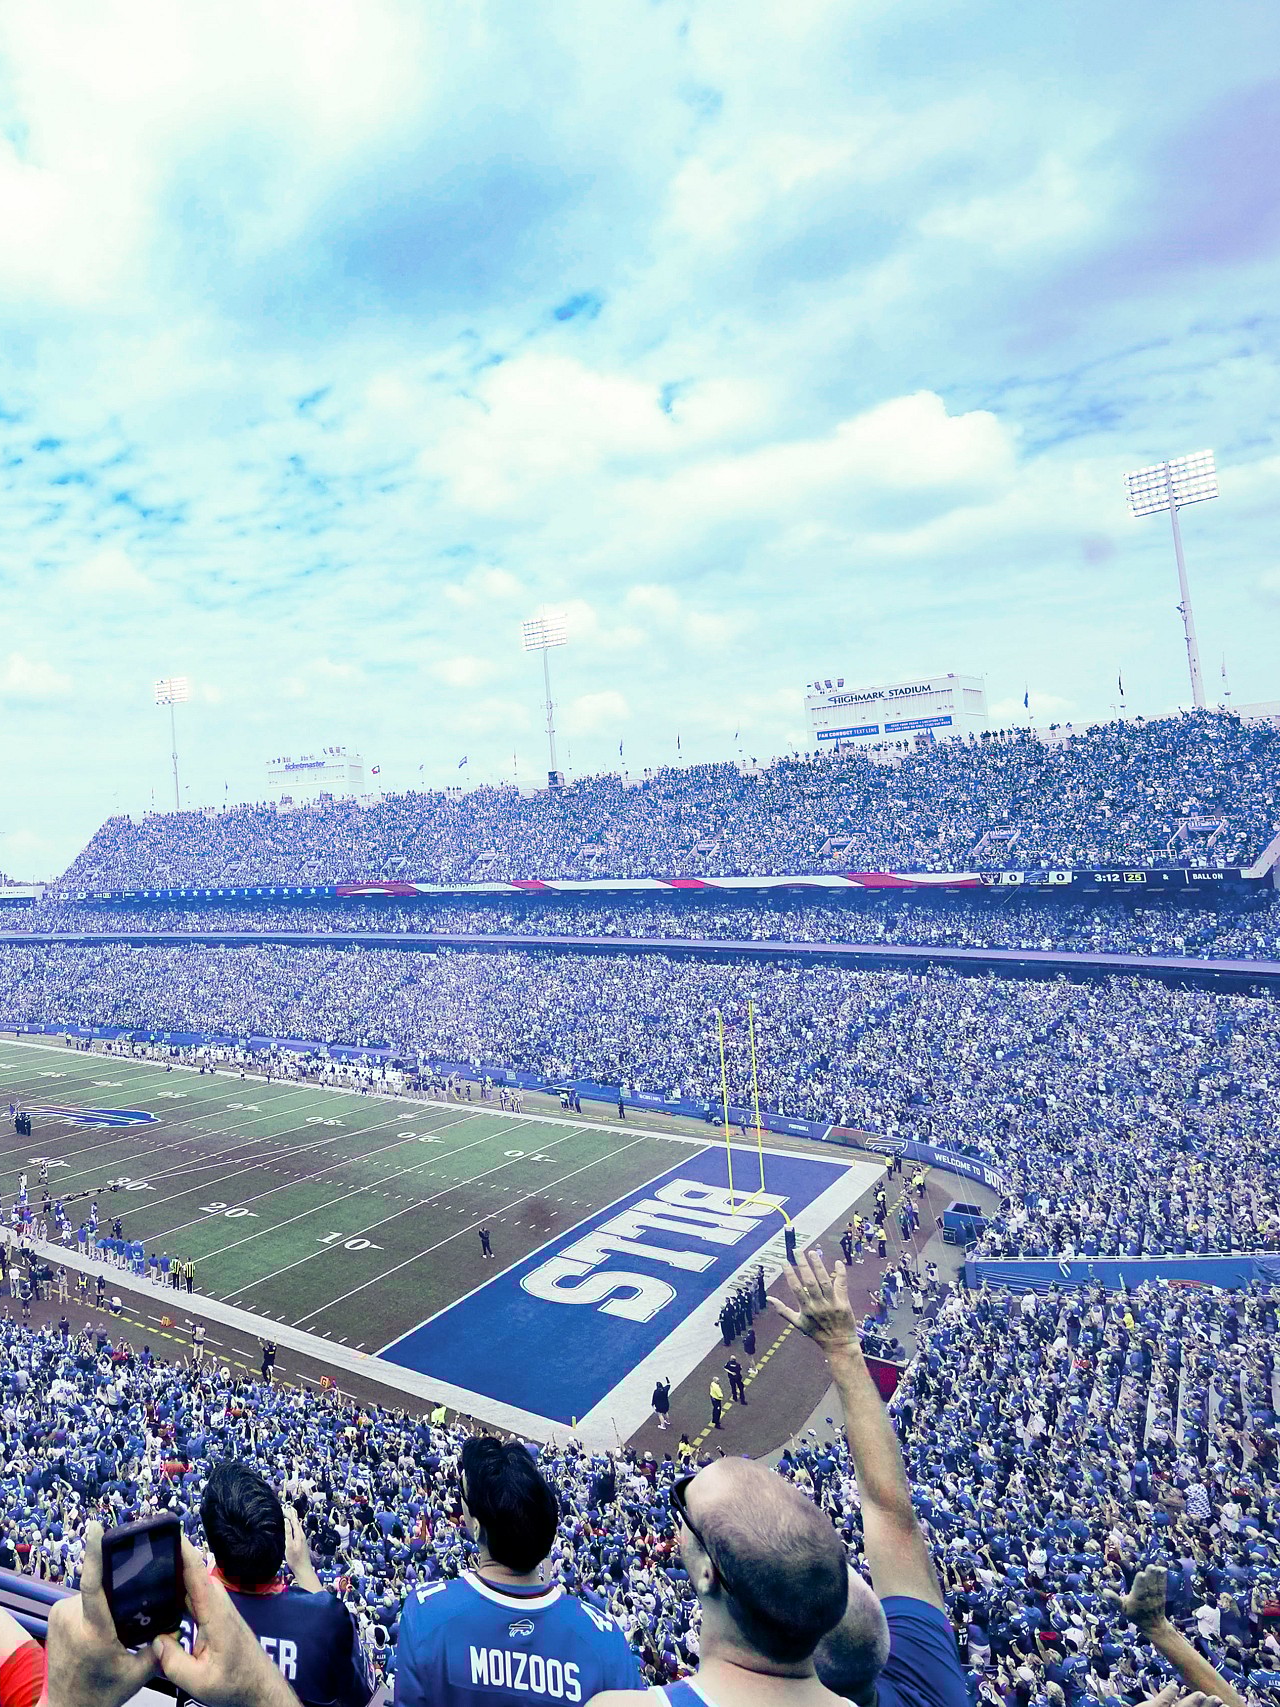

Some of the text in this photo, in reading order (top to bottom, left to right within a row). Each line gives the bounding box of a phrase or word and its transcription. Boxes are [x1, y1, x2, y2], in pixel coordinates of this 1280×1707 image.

[833, 684, 932, 705] HIGHMARK STADIUM
[284, 760, 326, 771] ticketmaster
[1009, 874, 1017, 882] 0
[1056, 873, 1064, 881] 0
[1094, 873, 1120, 882] 3:12
[503, 1149, 550, 1162] 10
[934, 1152, 972, 1172] WELCOME
[971, 1164, 982, 1176] TO
[107, 1177, 149, 1191] 30
[199, 1202, 251, 1219] 20
[317, 1231, 375, 1251] 10
[519, 1177, 791, 1323] BILLS
[958, 1633, 969, 1646] 17
[469, 1644, 583, 1703] MOIZOOS
